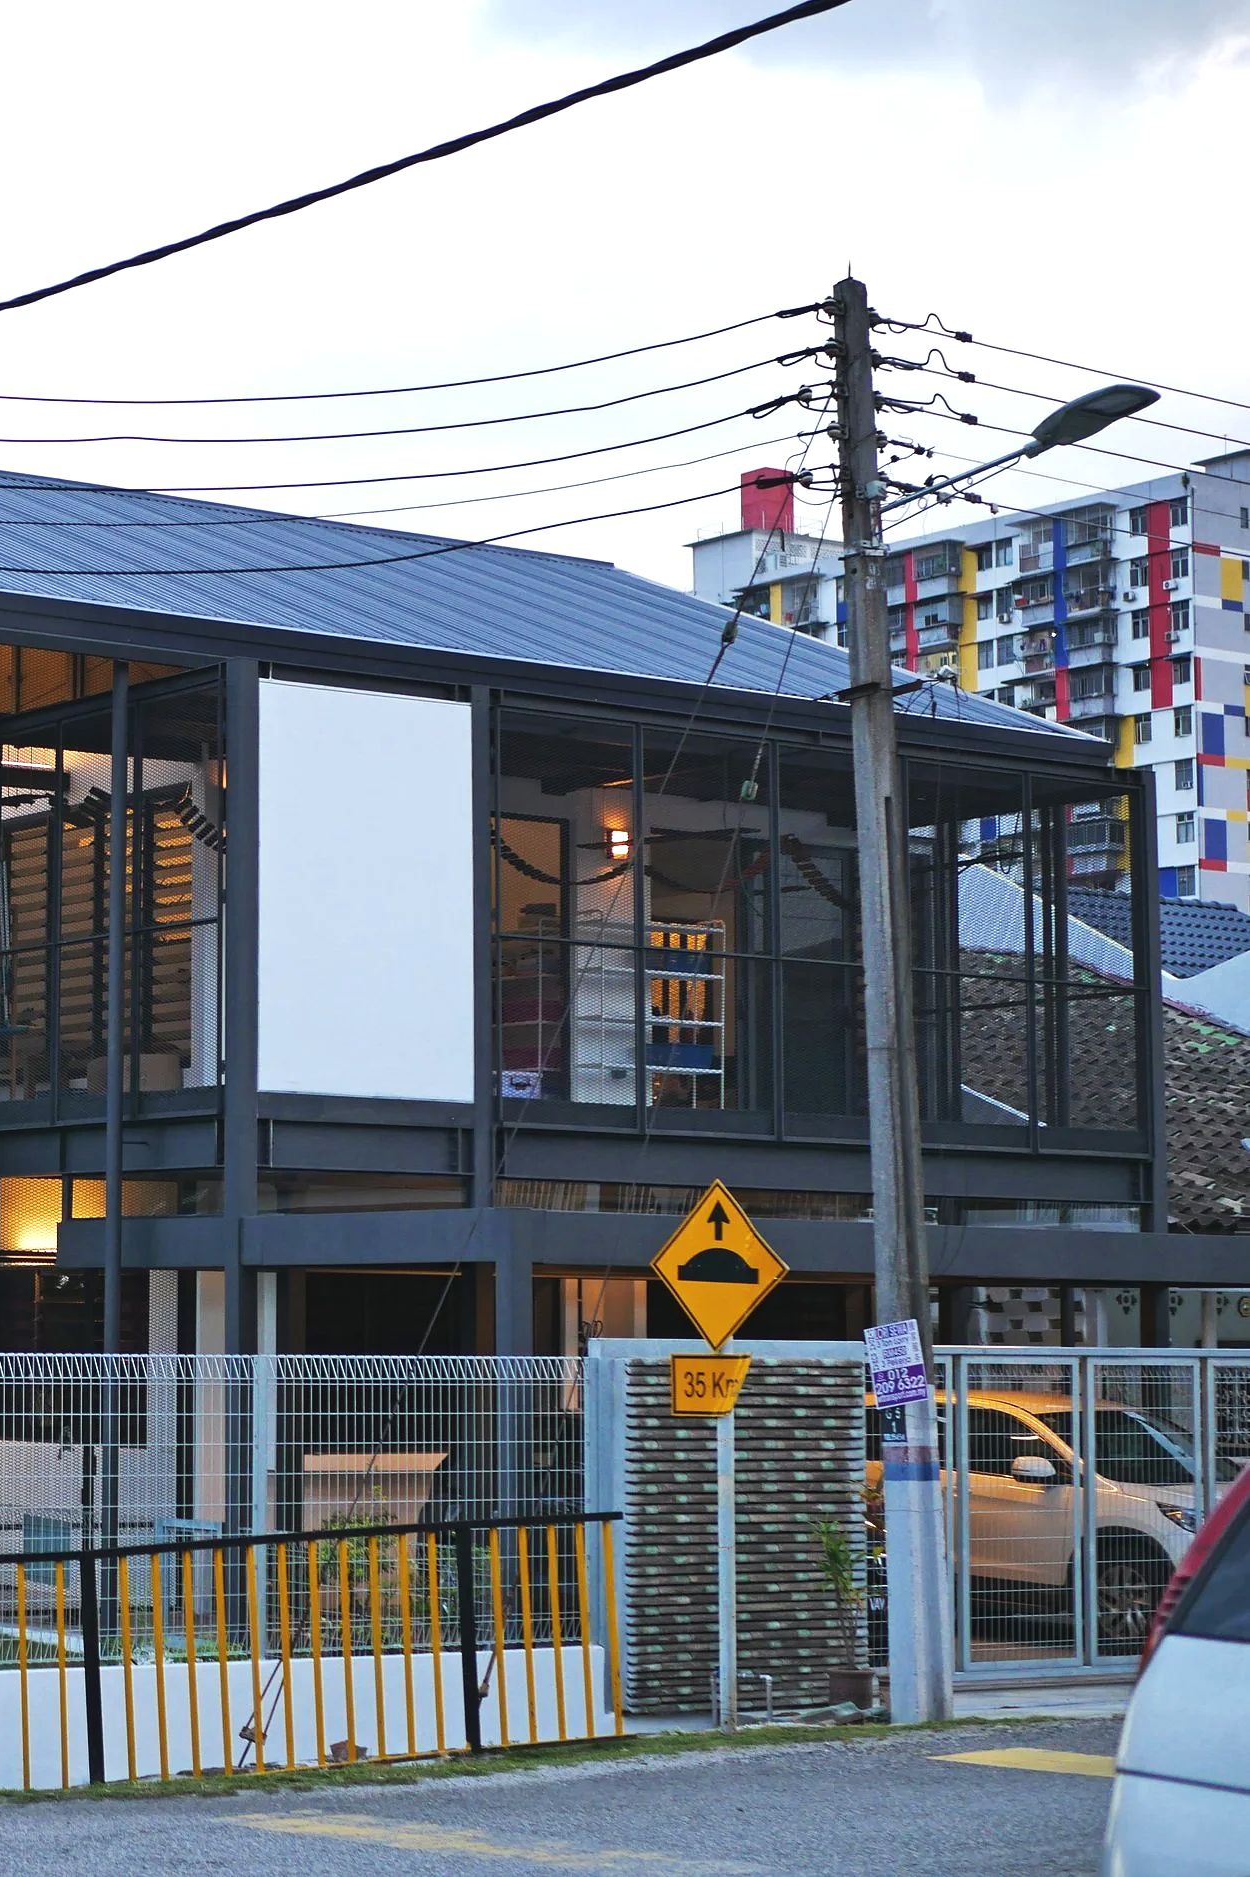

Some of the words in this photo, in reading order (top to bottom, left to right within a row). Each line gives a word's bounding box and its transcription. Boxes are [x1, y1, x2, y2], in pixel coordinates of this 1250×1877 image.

[683, 1371, 706, 1398] 35
[888, 1368, 909, 1381] 012
[875, 1381, 895, 1396] 209
[897, 1375, 926, 1391] 6322
